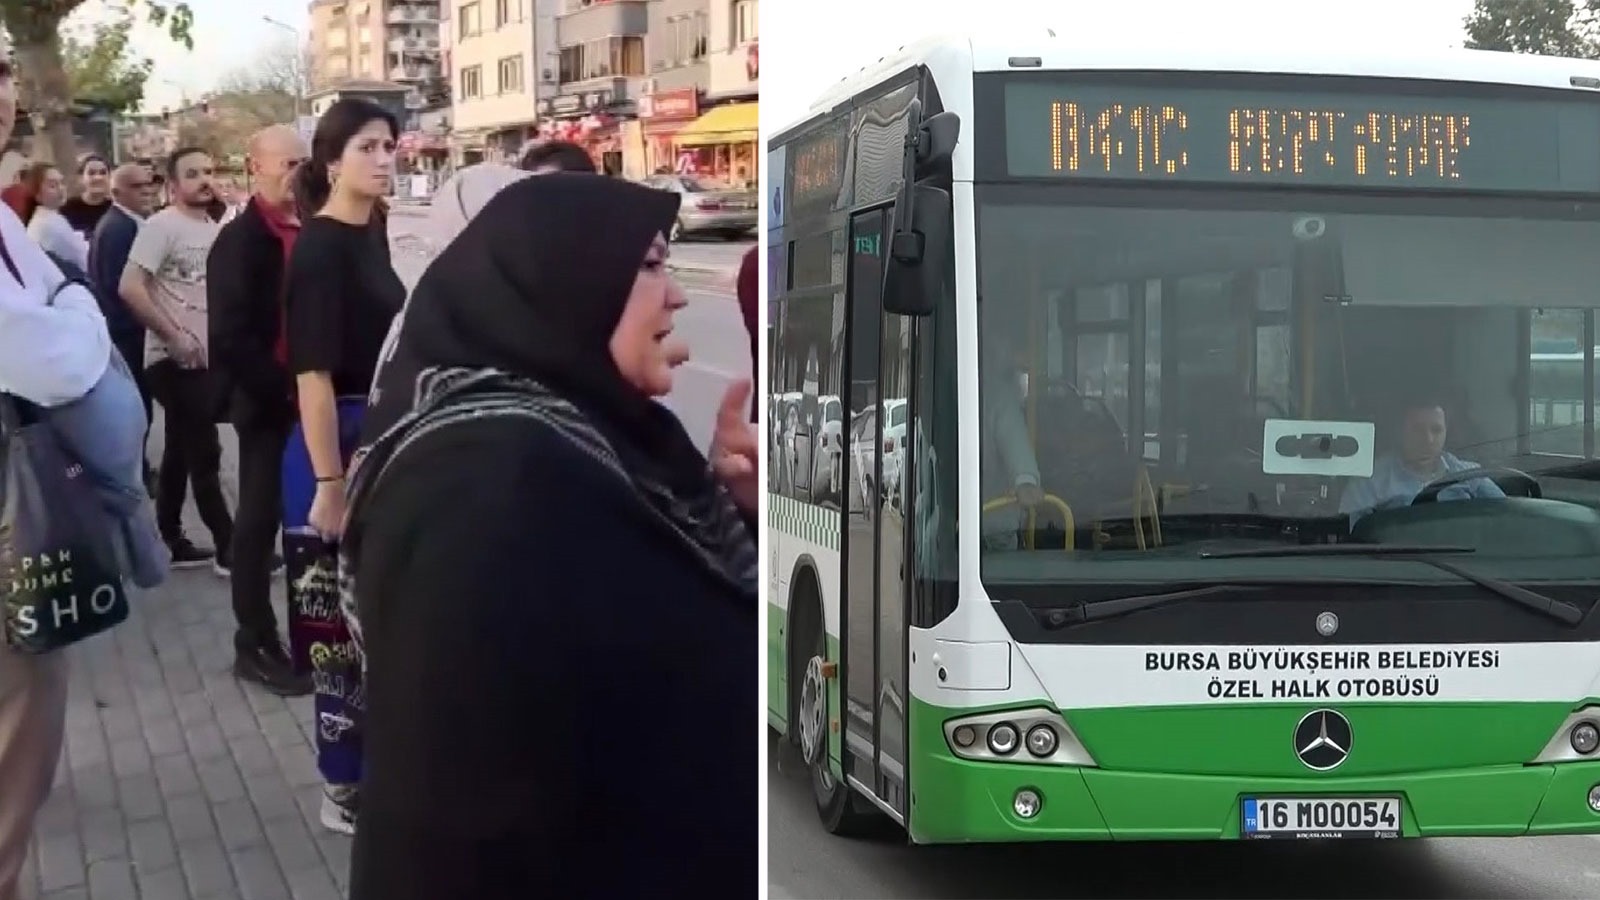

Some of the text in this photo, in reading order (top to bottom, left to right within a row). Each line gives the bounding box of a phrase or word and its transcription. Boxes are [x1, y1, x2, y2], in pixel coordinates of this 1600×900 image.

[1145, 651, 1220, 671] BURSA
[1207, 675, 1440, 698] ÖZEL HALK OTOBÜSÜ
[1246, 801, 1396, 829] TR 16 M00054
